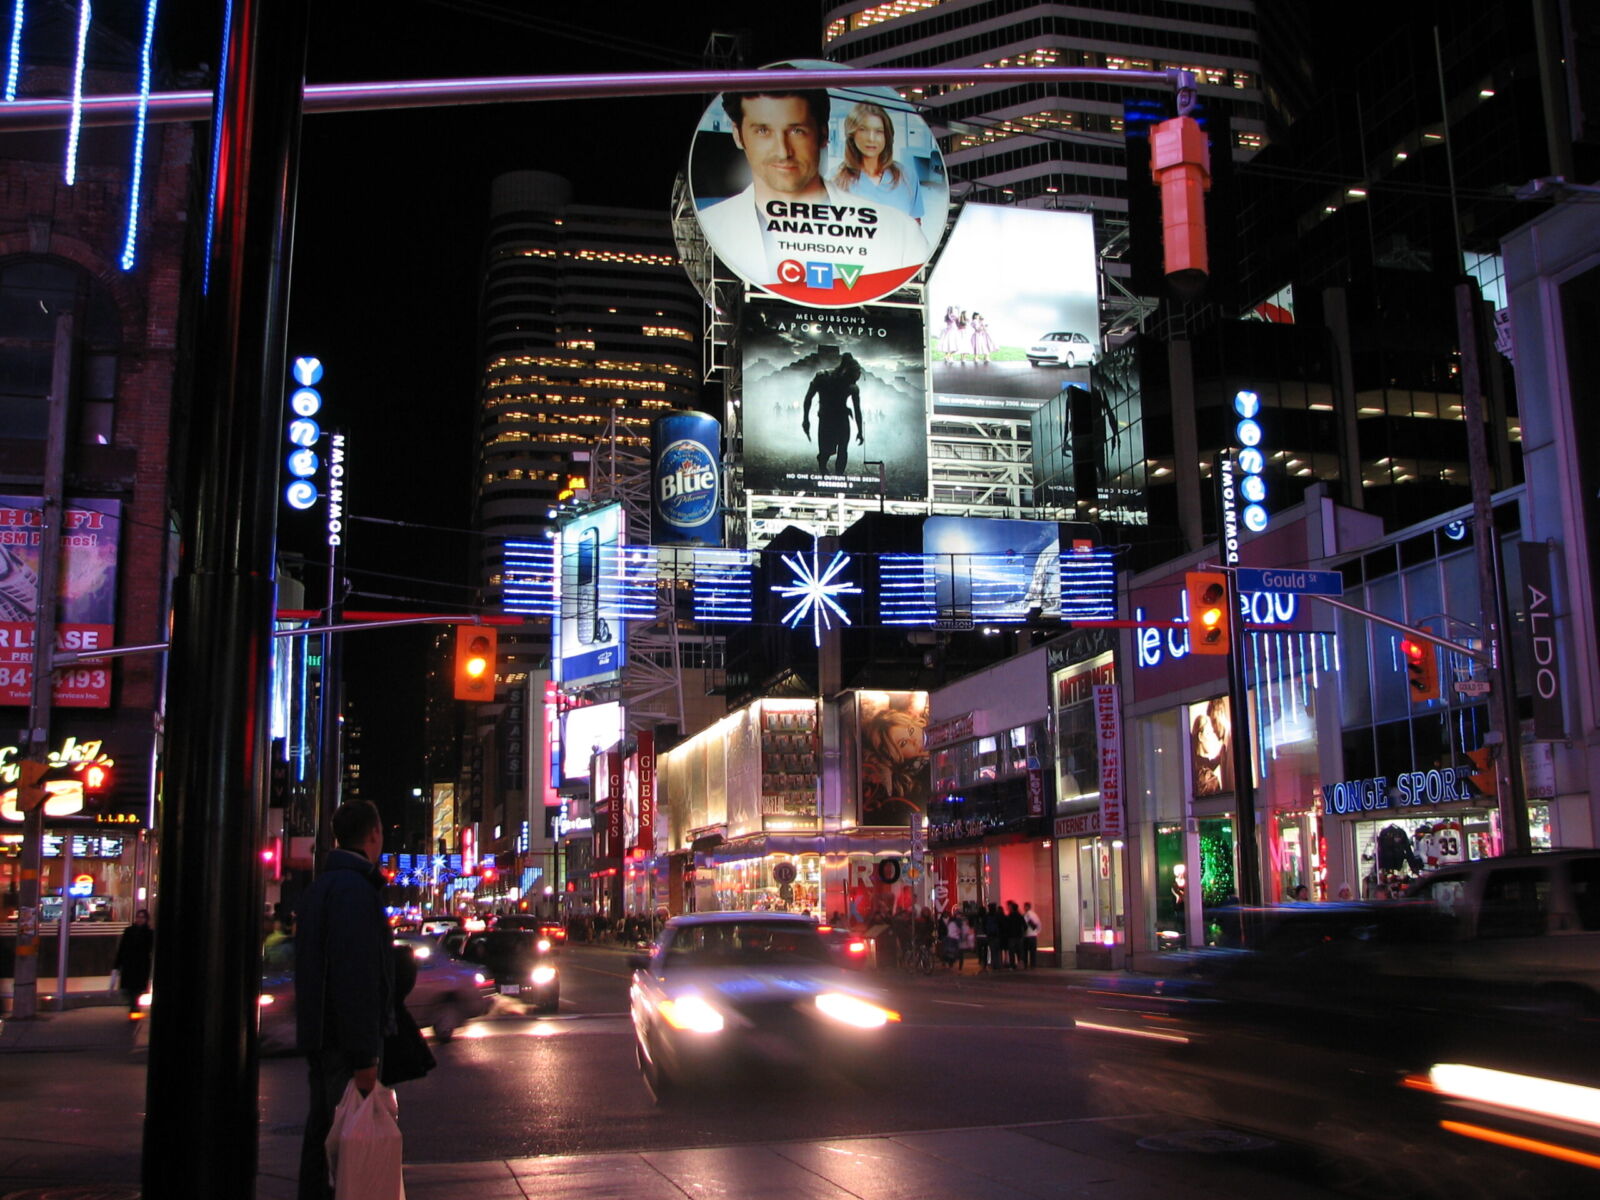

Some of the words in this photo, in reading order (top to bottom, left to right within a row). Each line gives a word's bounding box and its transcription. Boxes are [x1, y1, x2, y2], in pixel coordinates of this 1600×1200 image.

[766, 200, 878, 224] GREY'S
[766, 219, 877, 239] ANATOMY
[777, 240, 854, 255] THURSDAY
[858, 246, 867, 256] 8
[777, 260, 864, 289] CTV
[778, 322, 887, 338] APOCALYPTO
[818, 314, 866, 324] GIBSON'S
[287, 357, 323, 510] Yonge
[1235, 390, 1268, 532] Yonge
[329, 435, 345, 546] DOWNTOWN
[661, 471, 714, 502] Blue
[1222, 460, 1239, 562] DOWNTOWN
[1263, 572, 1306, 589] Gould
[1308, 574, 1317, 582] St
[1528, 584, 1556, 699] ALDO
[509, 690, 522, 771] SEARS
[1098, 687, 1116, 740] CENTRE
[610, 774, 620, 838] GUESS
[640, 756, 651, 828] GUESS
[1103, 748, 1120, 829] INTERNET
[1322, 776, 1389, 815] YONGE
[97, 814, 140, 824] L.L.B.O.
[1438, 838, 1458, 856] 33
